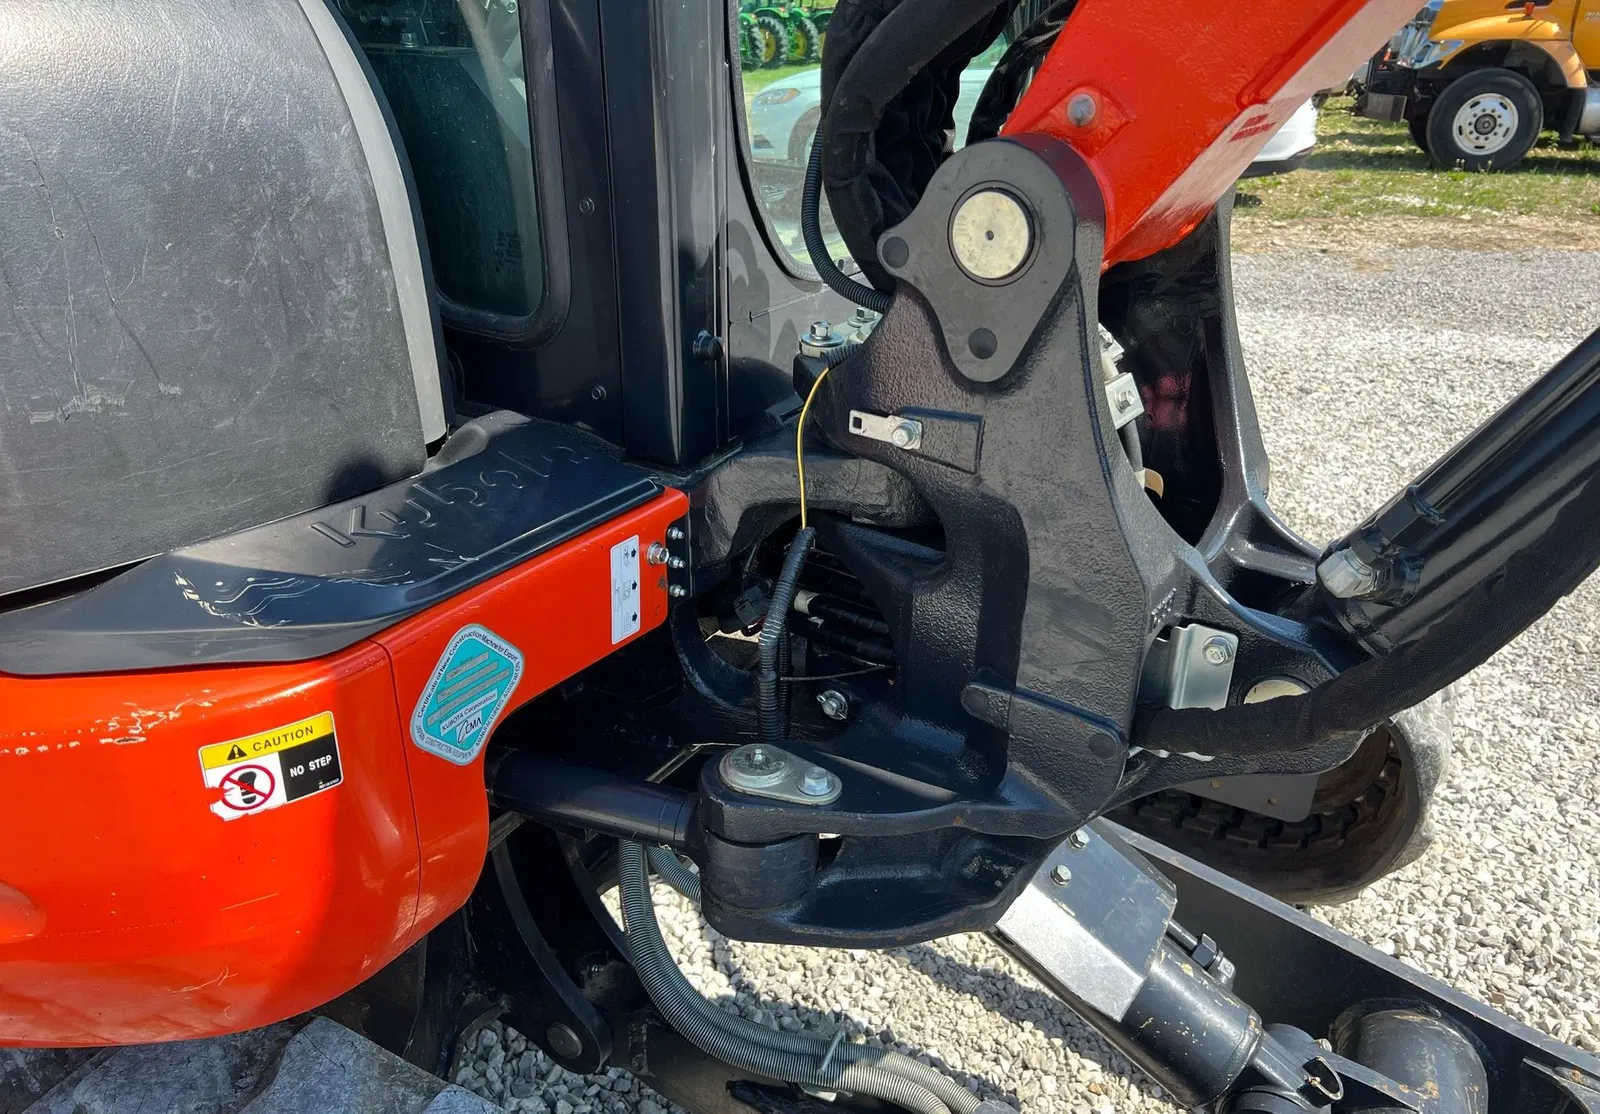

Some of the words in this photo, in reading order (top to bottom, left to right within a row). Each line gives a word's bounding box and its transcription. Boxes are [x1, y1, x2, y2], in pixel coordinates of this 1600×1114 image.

[440, 656, 451, 673] New
[441, 713, 464, 732] KUBOTA
[463, 693, 497, 715] Corporation
[252, 725, 314, 752] CAUTION
[289, 764, 305, 778] NO
[308, 754, 332, 771] STEP
